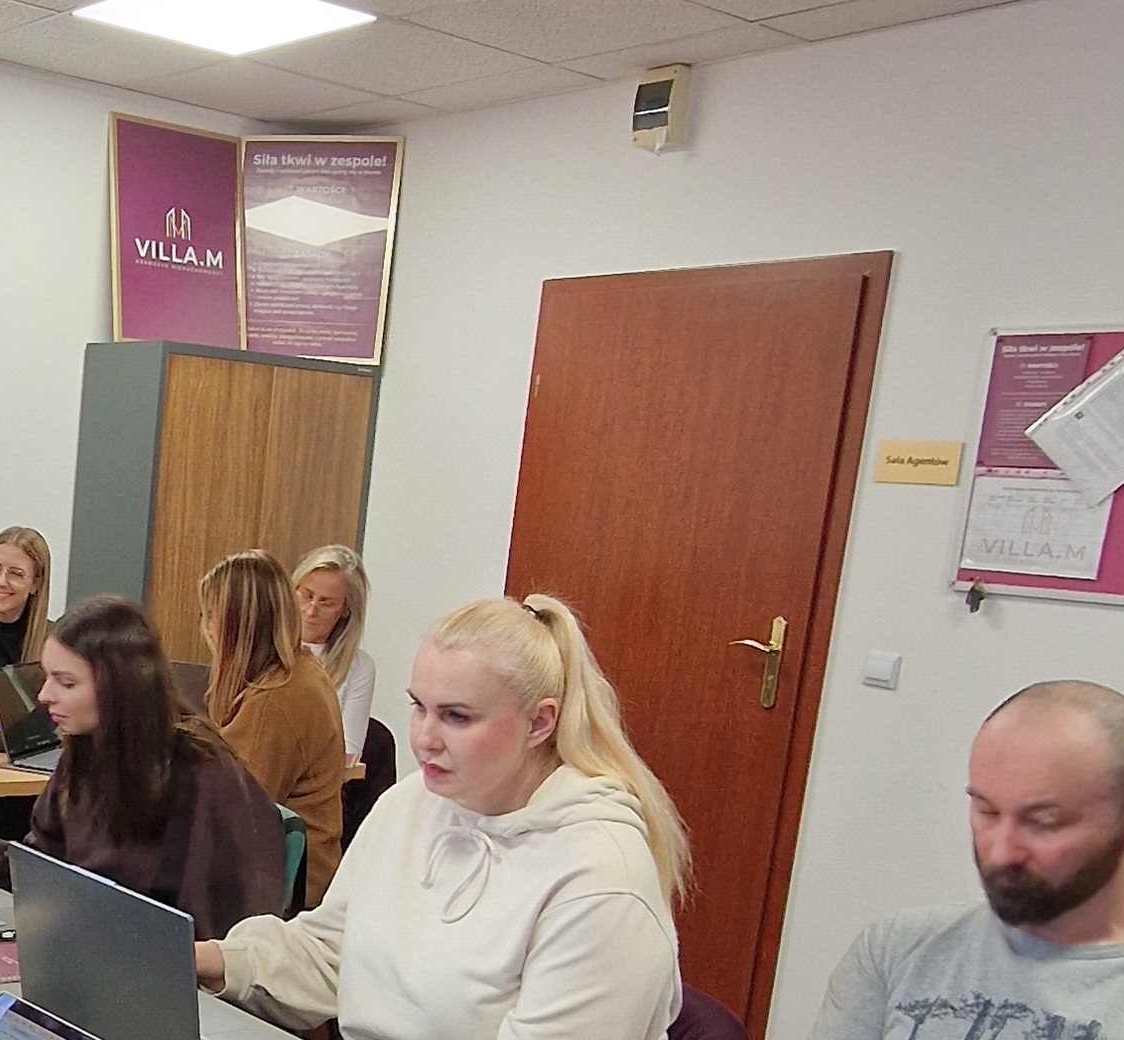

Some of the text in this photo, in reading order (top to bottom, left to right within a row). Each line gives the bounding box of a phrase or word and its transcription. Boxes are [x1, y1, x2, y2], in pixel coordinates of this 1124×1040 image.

[253, 154, 387, 169] Siła tkwi w zespole!
[135, 238, 223, 270] VILLA.M
[885, 454, 949, 468] Sala Agentów
[982, 538, 1086, 561] VILLA.M
